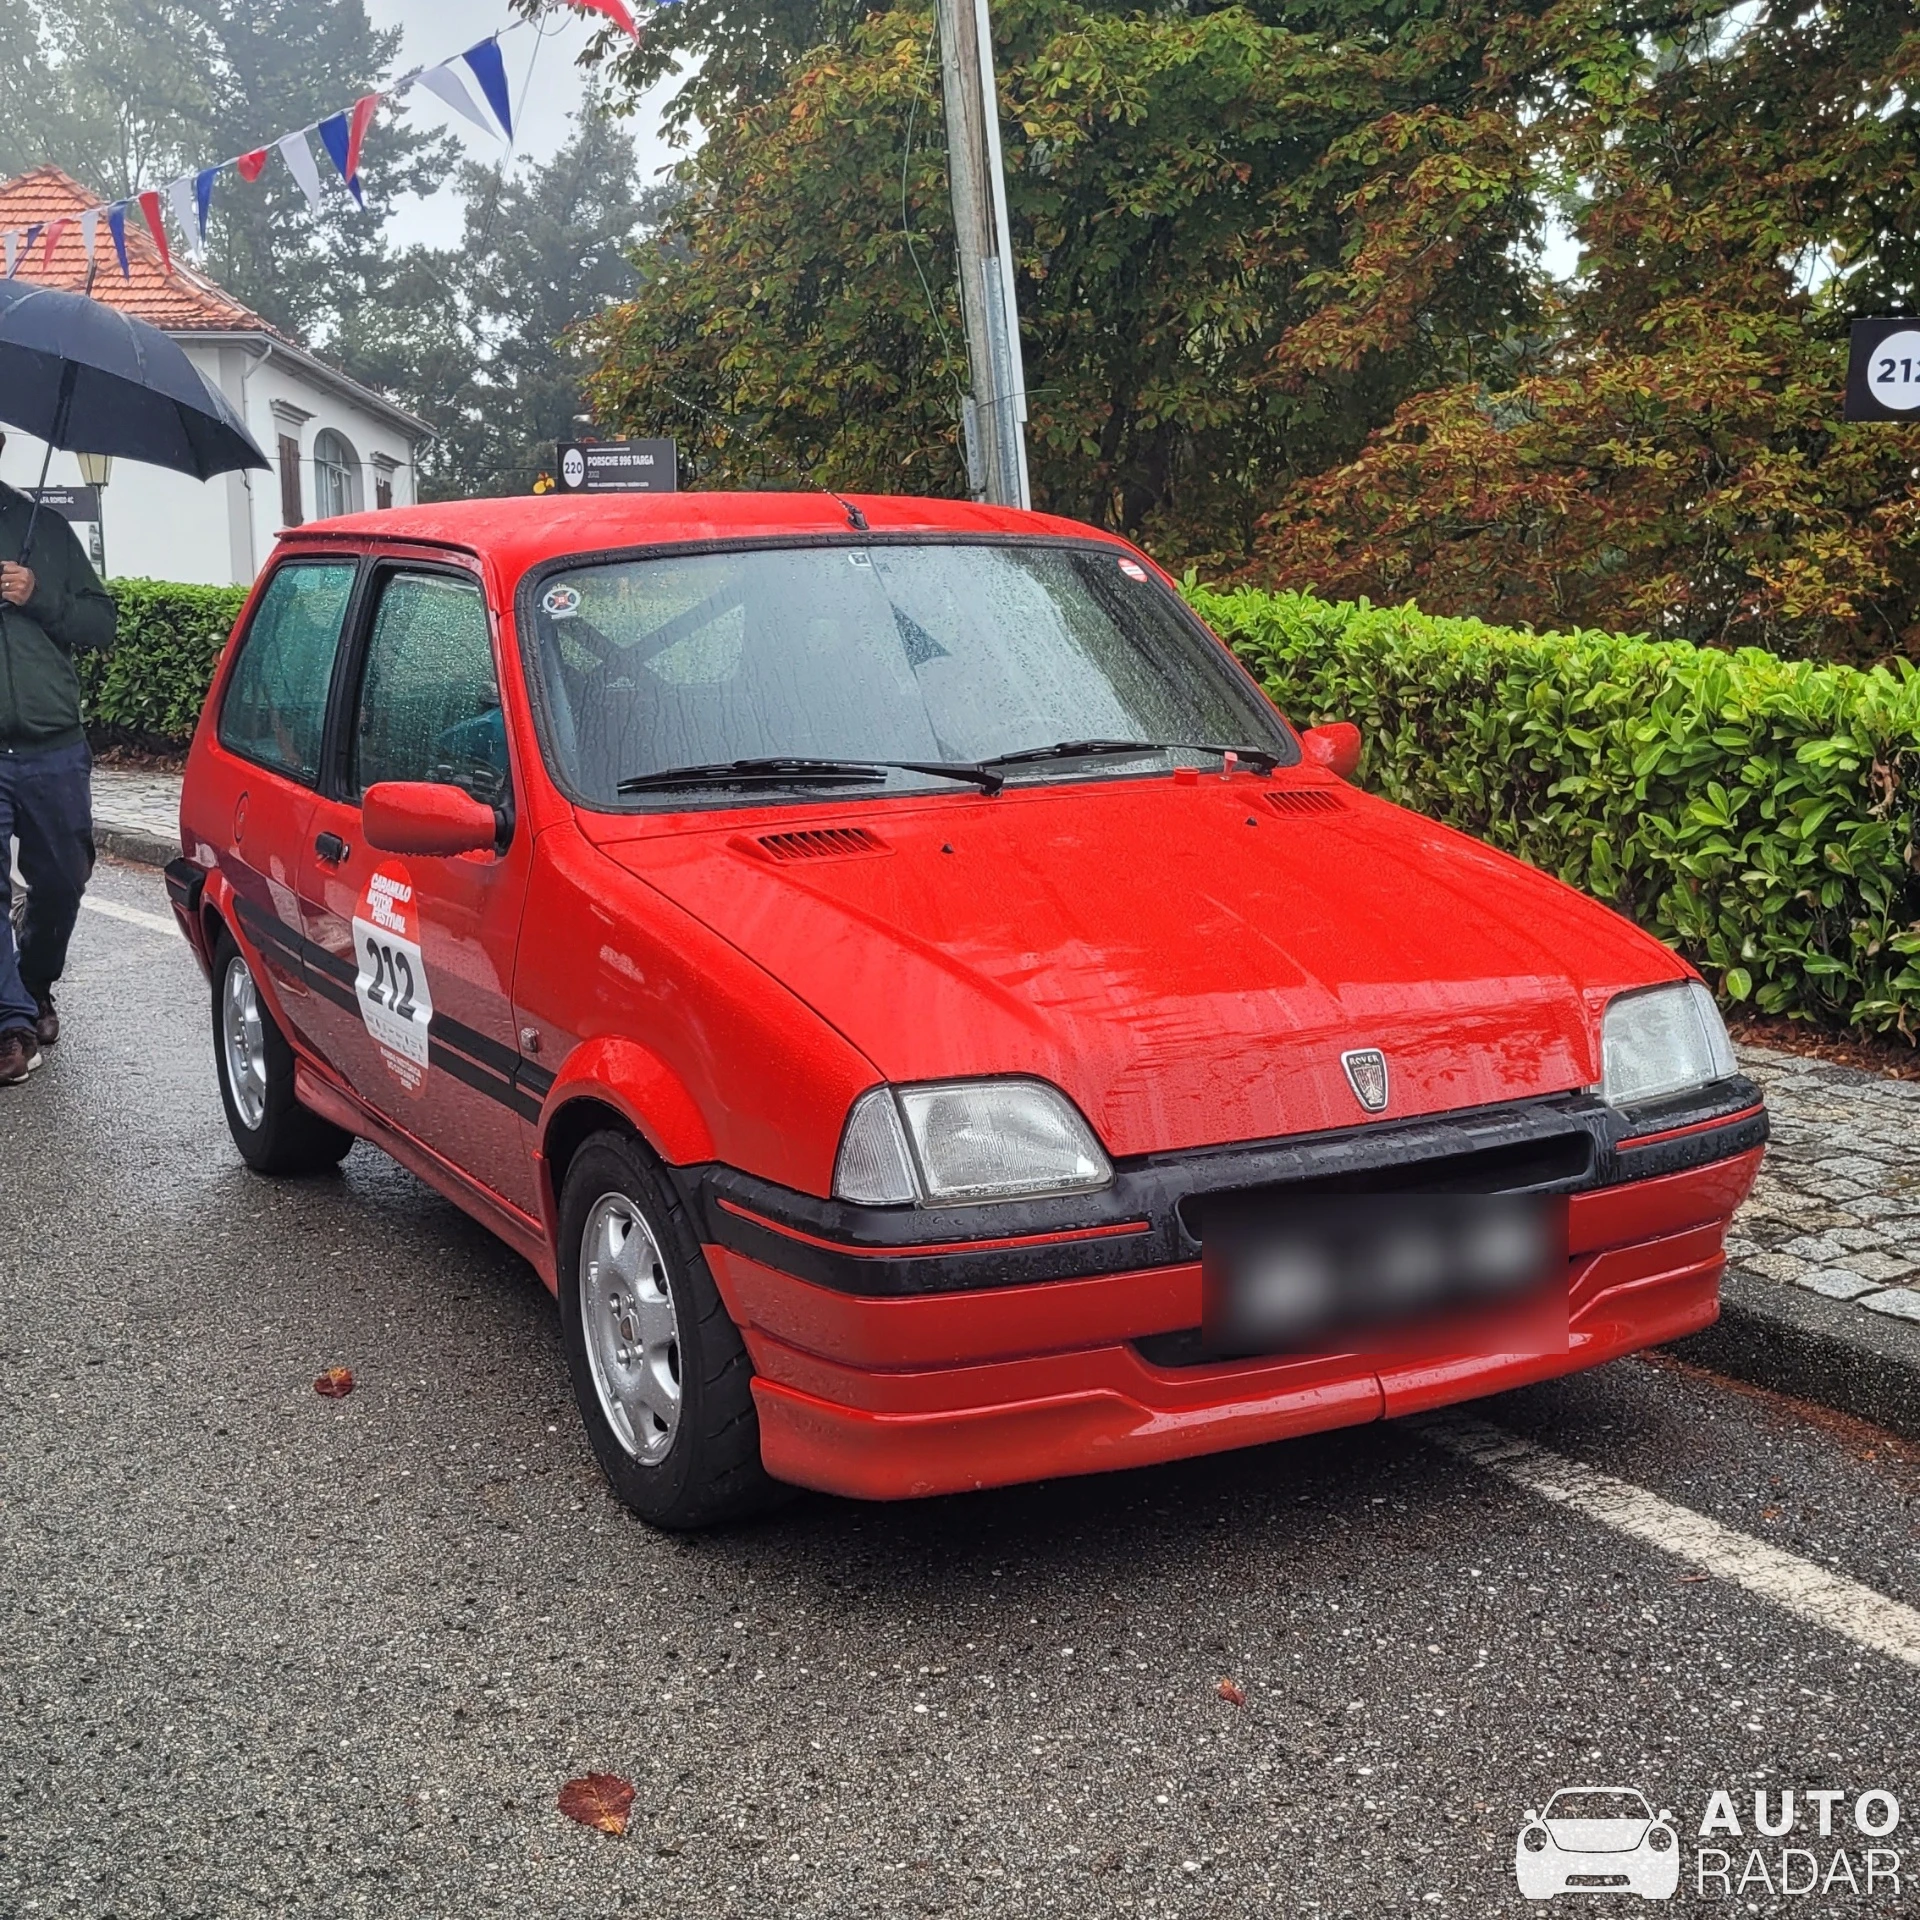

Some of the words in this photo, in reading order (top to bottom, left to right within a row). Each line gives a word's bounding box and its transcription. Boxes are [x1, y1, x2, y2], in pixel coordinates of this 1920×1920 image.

[564, 462, 582, 474] 220
[587, 456, 618, 466] PORSCHE
[619, 455, 632, 466] 996
[632, 454, 654, 465] TARGA
[371, 872, 412, 903] CARAMULO
[366, 888, 393, 912] MOTOR
[371, 907, 406, 934] FESTIVAL
[366, 937, 416, 1022] 212
[1349, 1054, 1379, 1065] ROVER
